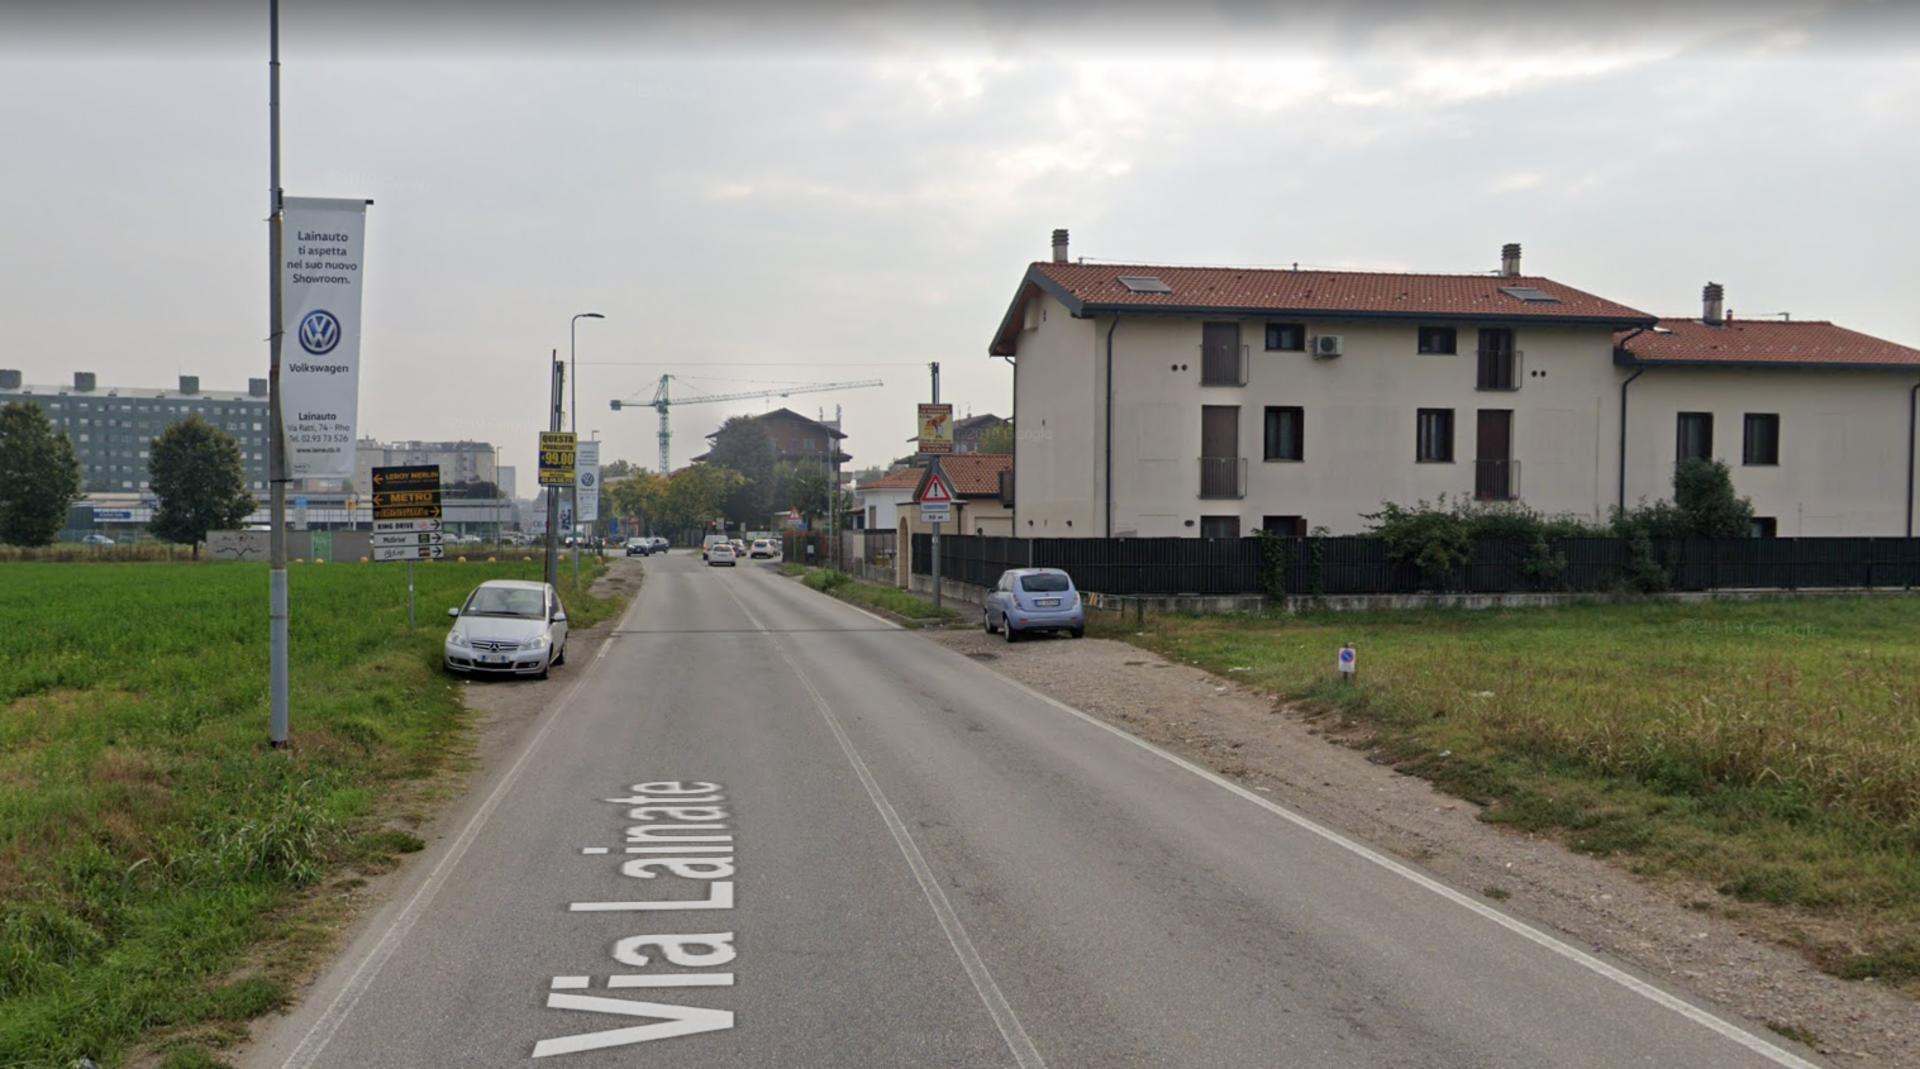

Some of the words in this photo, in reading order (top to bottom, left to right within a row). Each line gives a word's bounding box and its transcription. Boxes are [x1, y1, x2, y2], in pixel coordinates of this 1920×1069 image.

[298, 231, 349, 243] Lainauto
[298, 246, 306, 255] ti
[308, 247, 348, 258] aspetta
[287, 260, 303, 270] nel
[305, 262, 323, 270] suo
[325, 262, 358, 271] nuovo
[293, 273, 352, 285] Showroom.
[289, 363, 349, 375] Volkswagen
[298, 412, 337, 421] Lainauto
[390, 491, 432, 502] METRO
